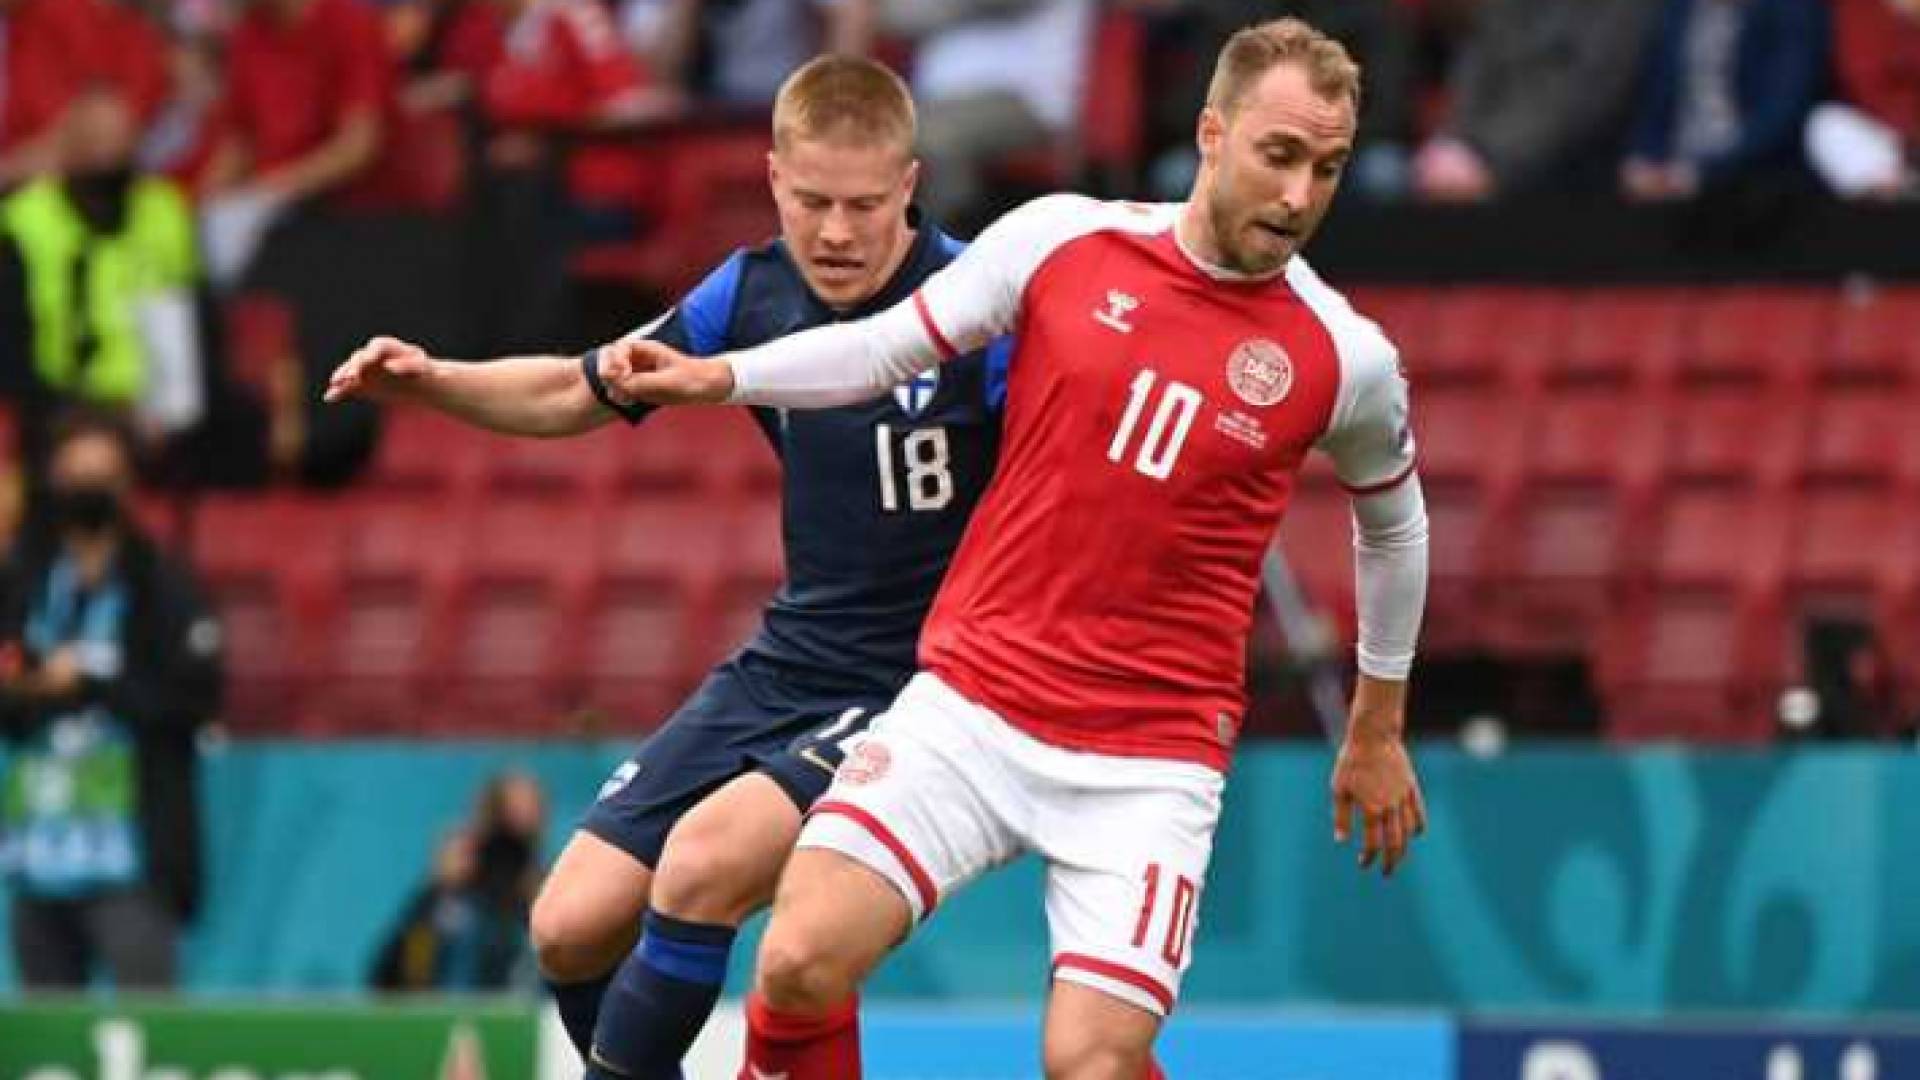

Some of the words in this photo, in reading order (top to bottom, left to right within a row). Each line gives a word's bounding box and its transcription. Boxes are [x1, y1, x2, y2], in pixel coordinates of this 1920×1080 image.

[876, 424, 954, 511] 18
[1106, 369, 1204, 480] 10
[1130, 861, 1195, 970] 10
